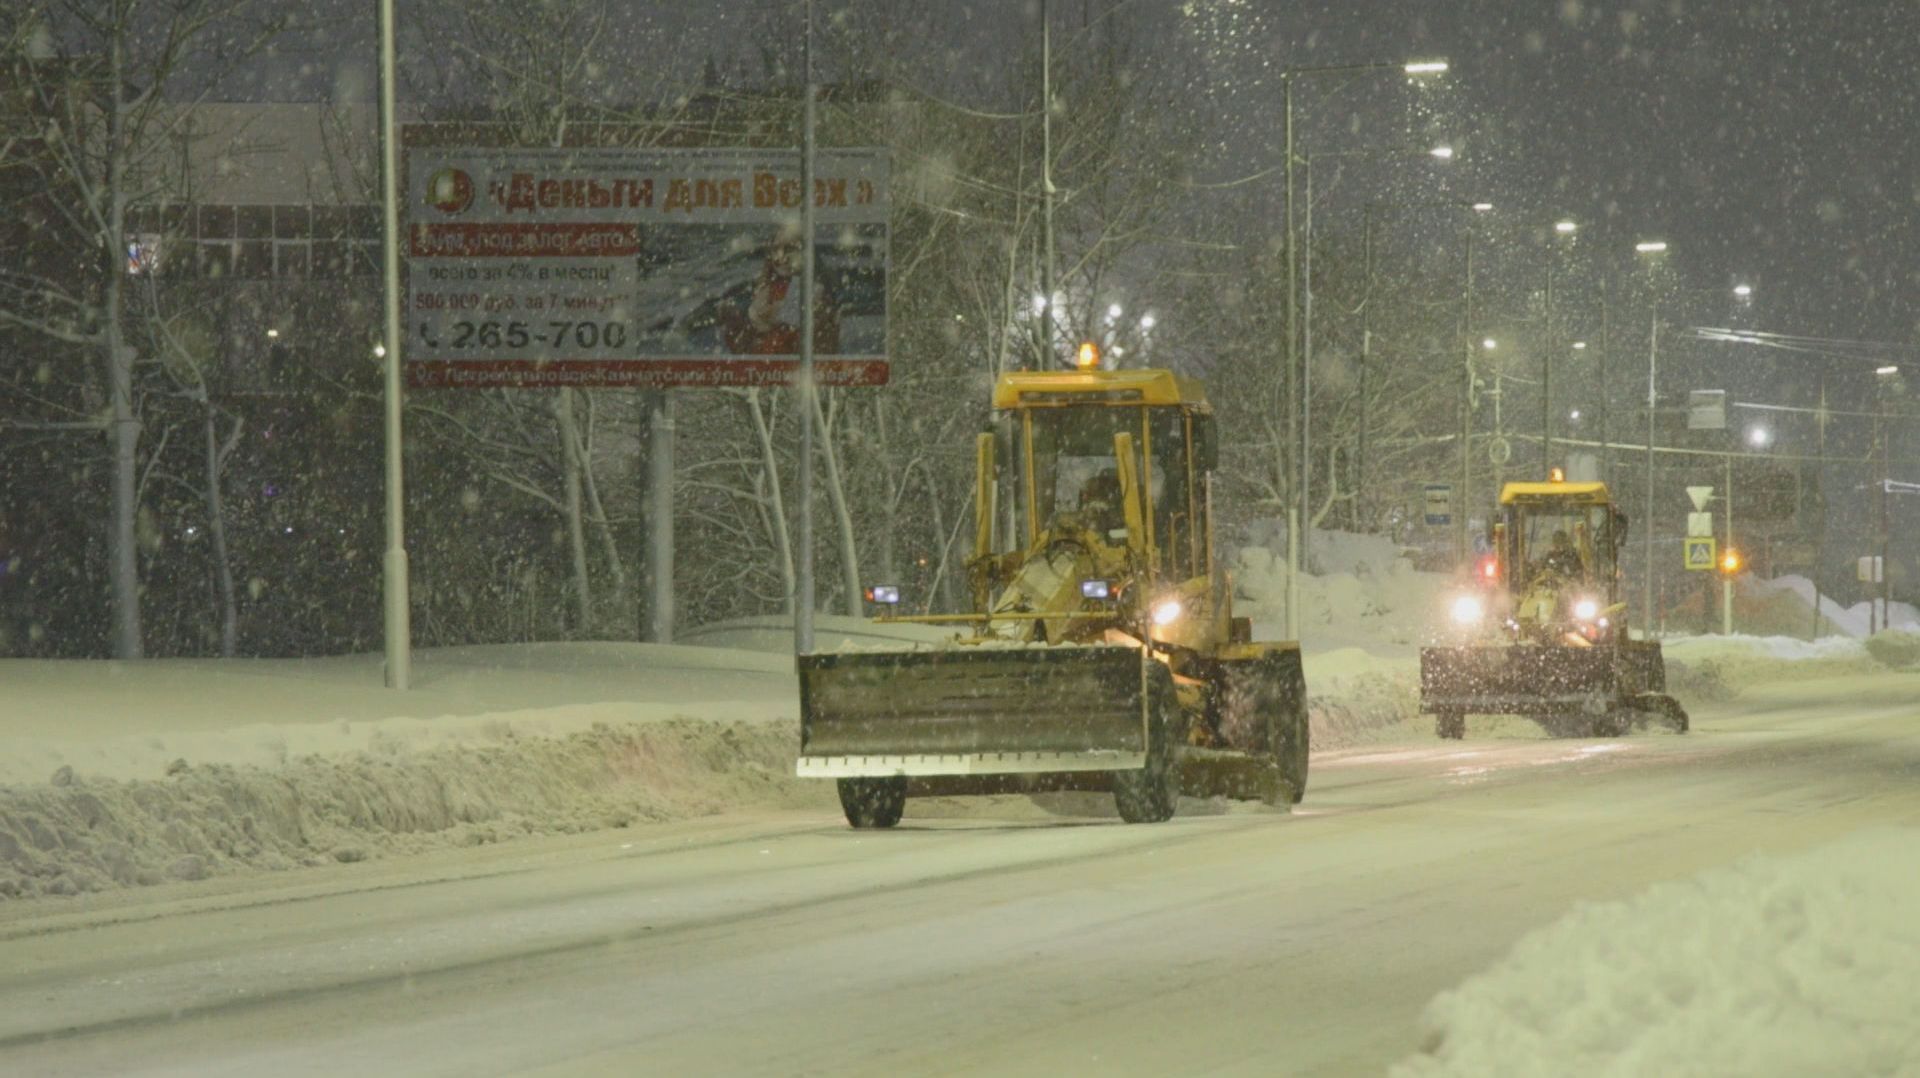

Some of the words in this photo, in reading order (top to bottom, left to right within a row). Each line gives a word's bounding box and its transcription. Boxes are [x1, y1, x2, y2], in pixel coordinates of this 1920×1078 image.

[664, 178, 743, 213] для
[538, 267, 549, 280] в
[450, 320, 627, 349] 265-700
